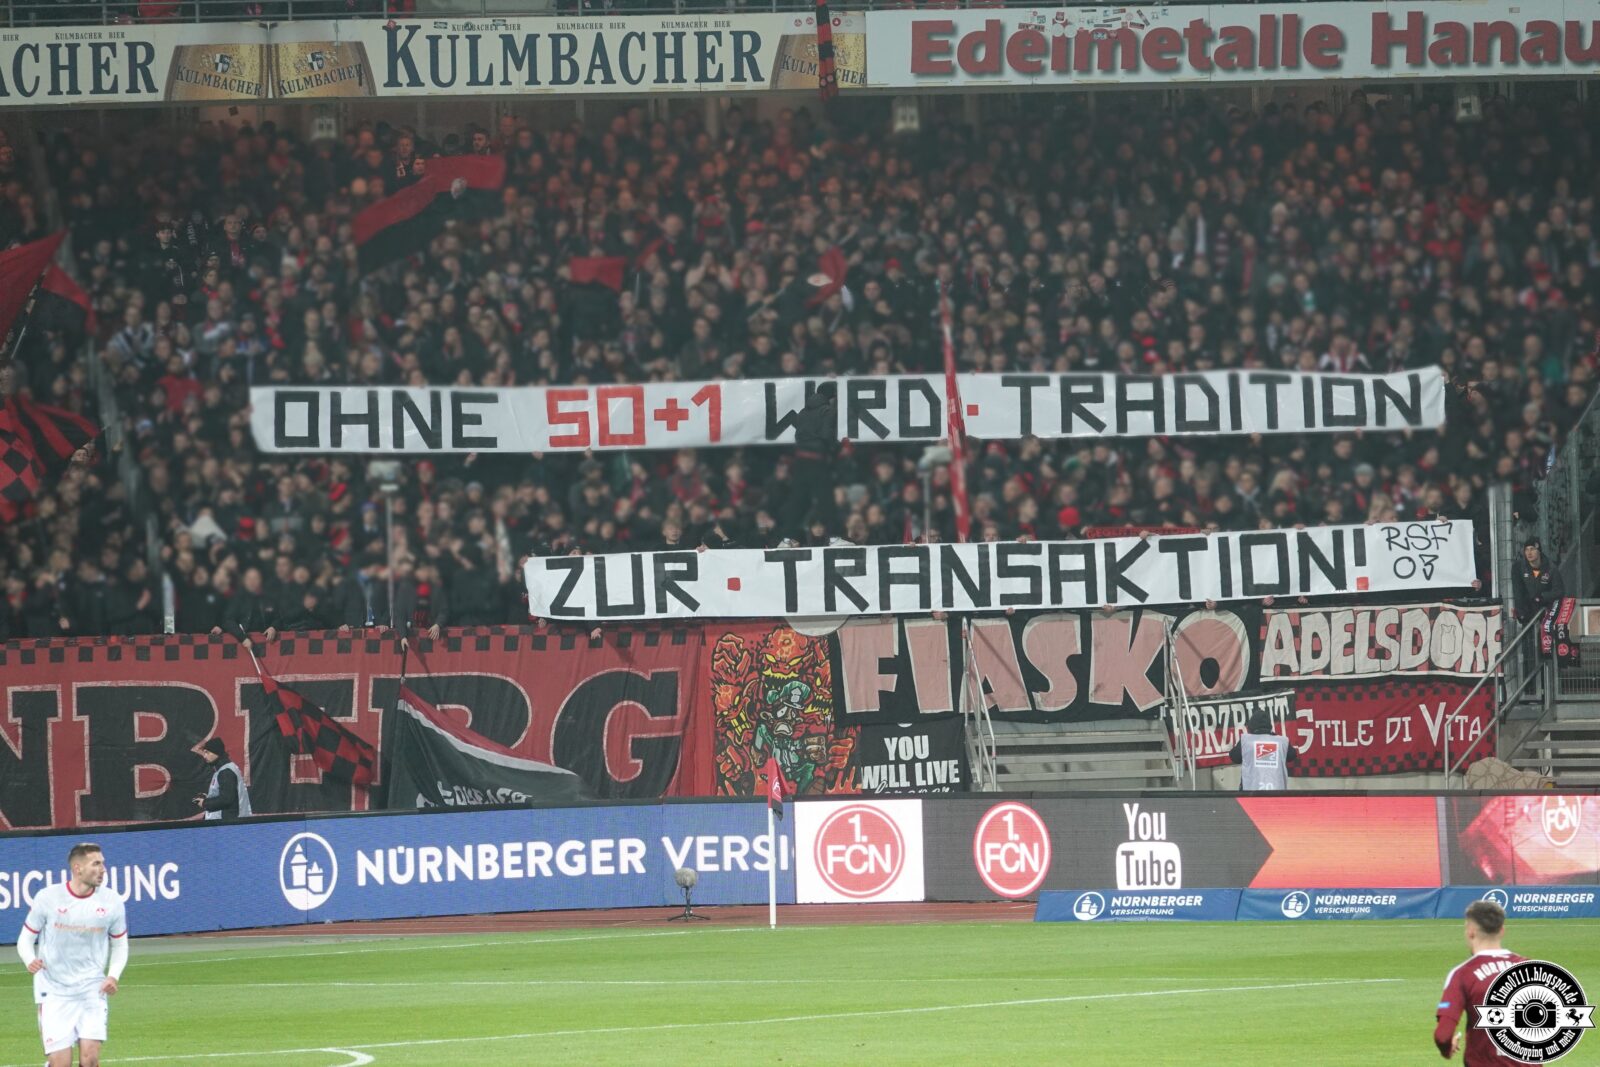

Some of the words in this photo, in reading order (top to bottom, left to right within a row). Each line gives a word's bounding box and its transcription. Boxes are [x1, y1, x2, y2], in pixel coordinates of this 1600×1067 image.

[55, 31, 102, 40] KULMBACHER
[108, 31, 125, 40] BIER
[505, 23, 521, 31] BIER
[556, 22, 604, 30] KULMBACHER
[609, 21, 626, 29] BIER
[661, 20, 708, 29] KULMBACHER
[714, 20, 731, 28] BIER
[1370, 10, 1600, 67] Hanau
[0, 41, 159, 98] CHER
[382, 24, 766, 89] KULMBACHER
[781, 54, 868, 85] KULMCHER
[176, 64, 263, 97] KULMBACHER
[274, 389, 498, 449] OHNE
[1000, 372, 1424, 434] TRADITION
[545, 551, 701, 617] ZUR
[764, 527, 1370, 613] TRANSAKTION!
[1260, 606, 1502, 677] ADELSDORF
[837, 609, 1250, 714] FIASKO
[883, 734, 930, 761] YOU
[861, 763, 910, 789] WILL
[914, 759, 960, 786] LIVE
[1122, 802, 1167, 840] You
[357, 837, 647, 887] NÜRNBERGER
[825, 843, 893, 876] FCN
[984, 842, 1040, 874] FCN
[1121, 850, 1177, 887] Tube
[1109, 907, 1175, 916] VERSICHERUNG
[1110, 895, 1203, 907] NÜRNBERGER
[1313, 906, 1371, 914] VERSICHERUNG
[1314, 894, 1396, 906] NÜRNBERGER
[1512, 905, 1569, 913] VERSICHERUNG
[1513, 892, 1595, 904] NÜRNBERGER
